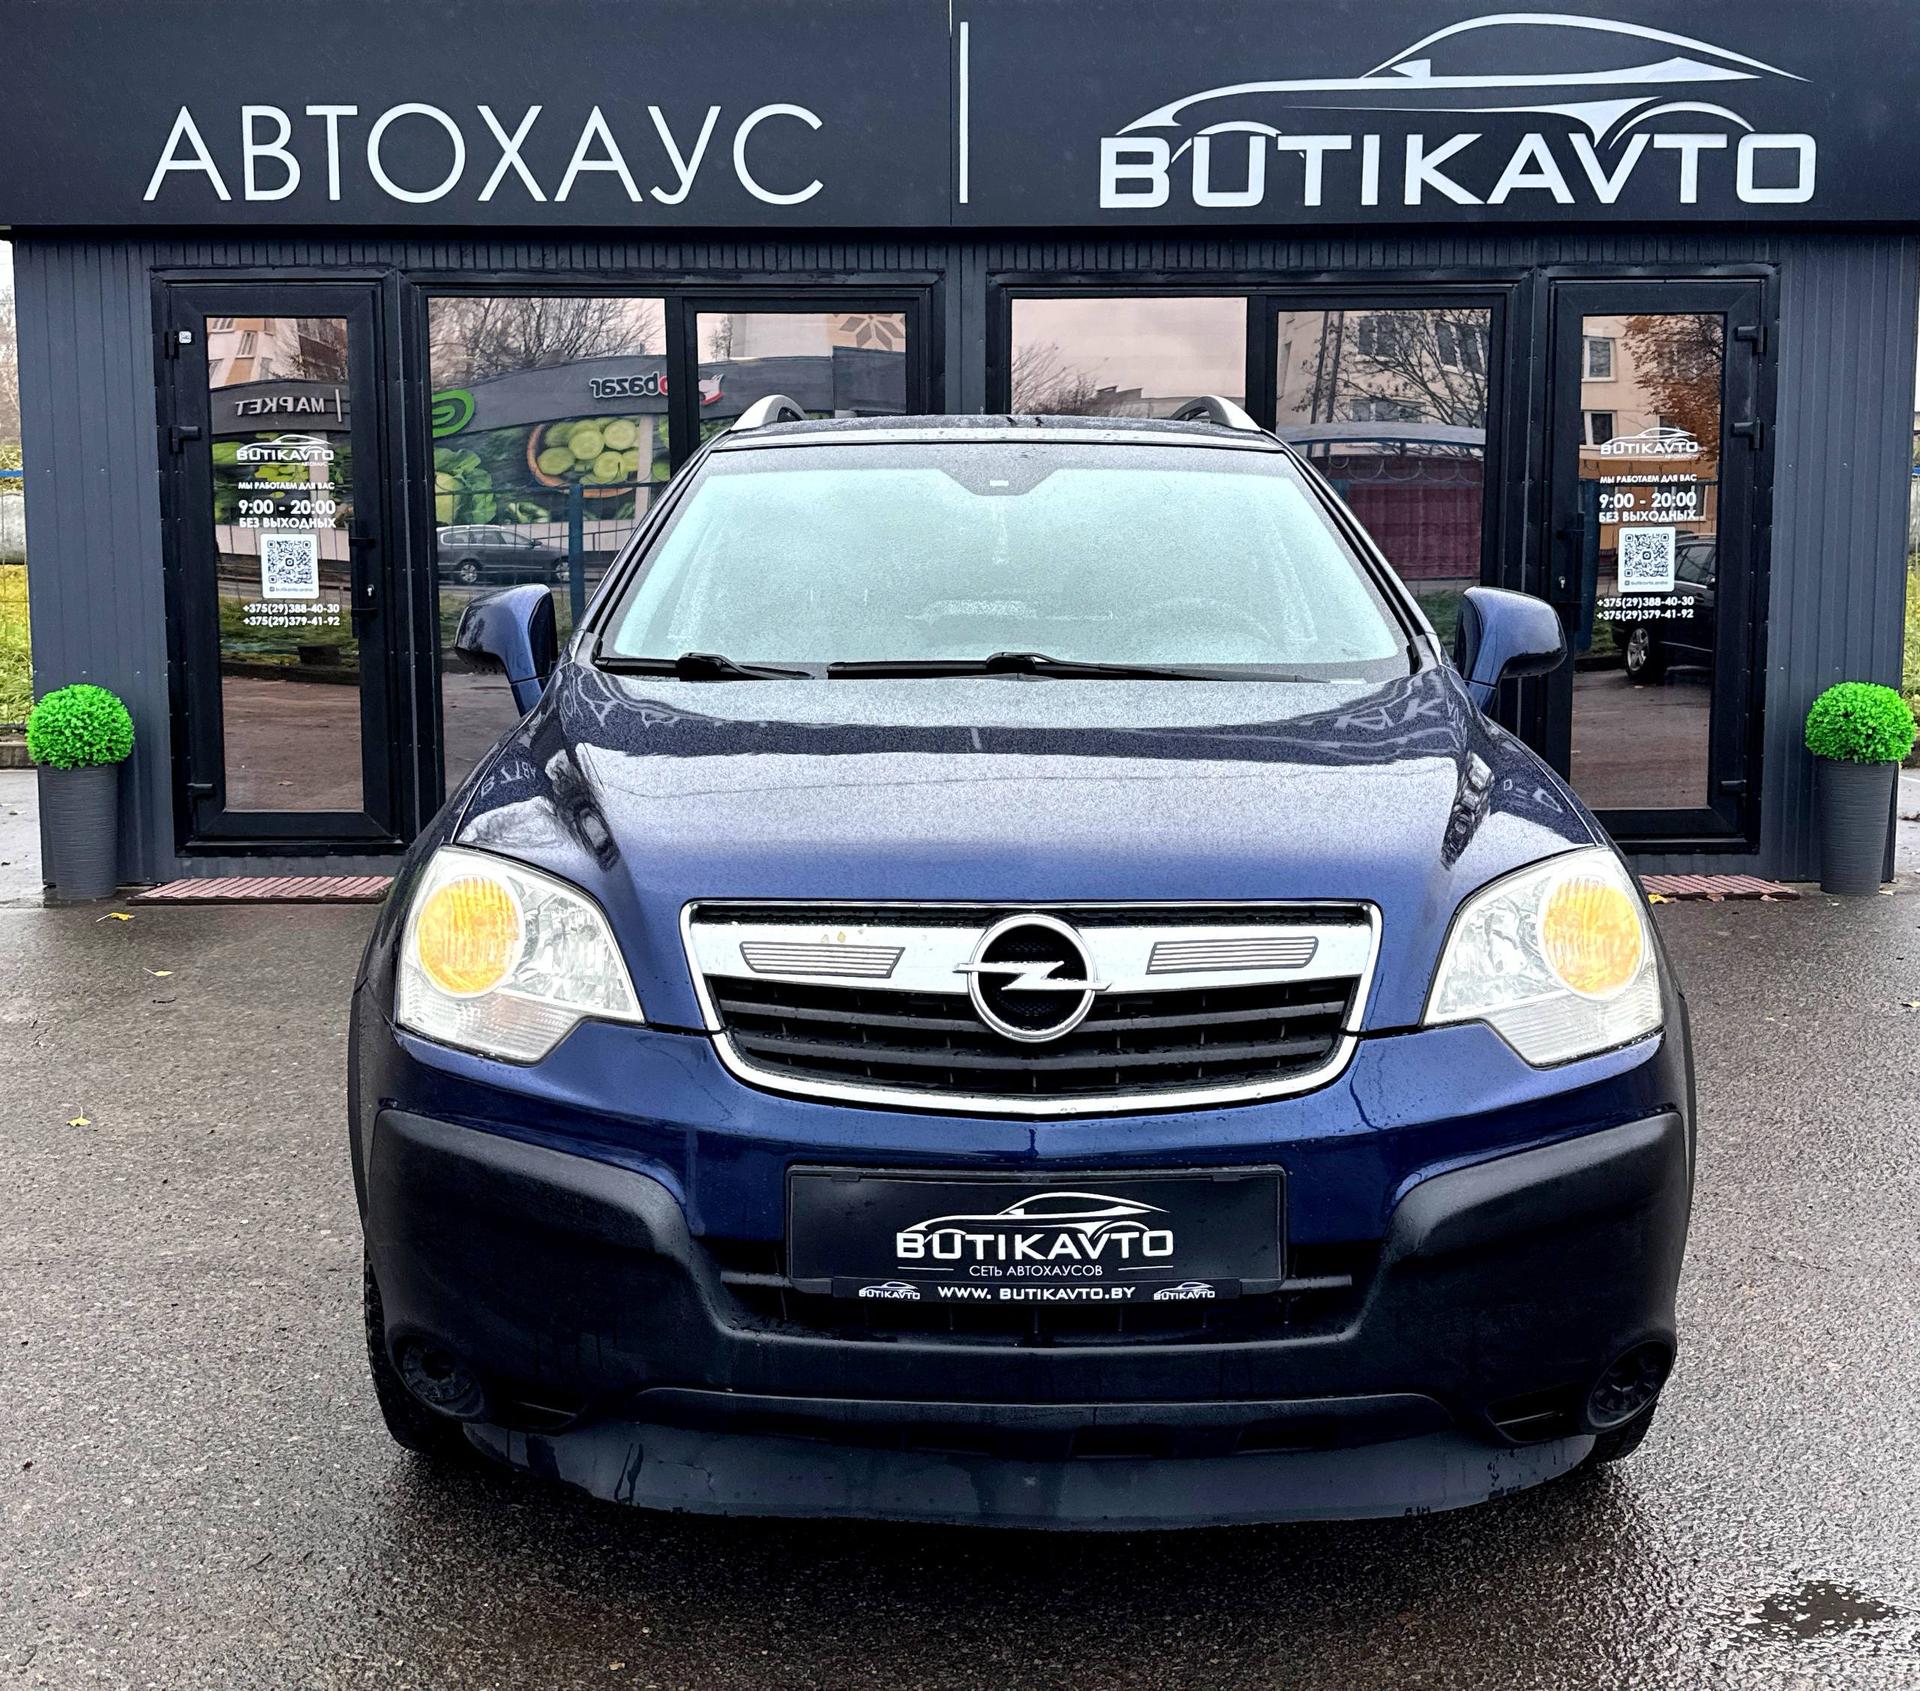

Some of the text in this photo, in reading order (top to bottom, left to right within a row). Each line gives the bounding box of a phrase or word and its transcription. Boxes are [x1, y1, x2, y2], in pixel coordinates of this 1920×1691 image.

[143, 102, 824, 206] АВТОХАУС
[1099, 132, 1817, 209] BUTIKAVTO
[236, 448, 335, 461] BUTIKAVTO
[1600, 441, 1698, 455] BUTIKAVTO
[1599, 473, 1698, 484] МЫ РАБОТАЕМ ДЛЯ ВАС
[237, 481, 335, 490] МЫ РАБОТАЕМ ДЛЯ ВАС
[1599, 492, 1635, 509] 9:00
[1650, 491, 1697, 508] 20:00
[238, 499, 274, 515] 9:00
[290, 499, 336, 515] 20:00
[1598, 509, 1697, 523] БЕЗ ВЫХОДНЫХ
[239, 517, 337, 530] БЕЗ ВЫХОДНЫХ
[242, 603, 340, 615] +375(29)388-40-30
[1596, 596, 1695, 609] +375(29)388-40-30
[243, 615, 340, 628] +375(29)379-41-92
[1596, 608, 1694, 622] +375(29)379-41-92
[896, 1230, 1174, 1261] BUTIKAVTO
[969, 1264, 1103, 1277] СЕТЬ АВТОХАУСОВ
[858, 1288, 921, 1300] BUTIKAVTO
[937, 1286, 1136, 1300] WWW. BUTIKAVTO.BY
[1153, 1289, 1216, 1301] BUTIKAVTO
